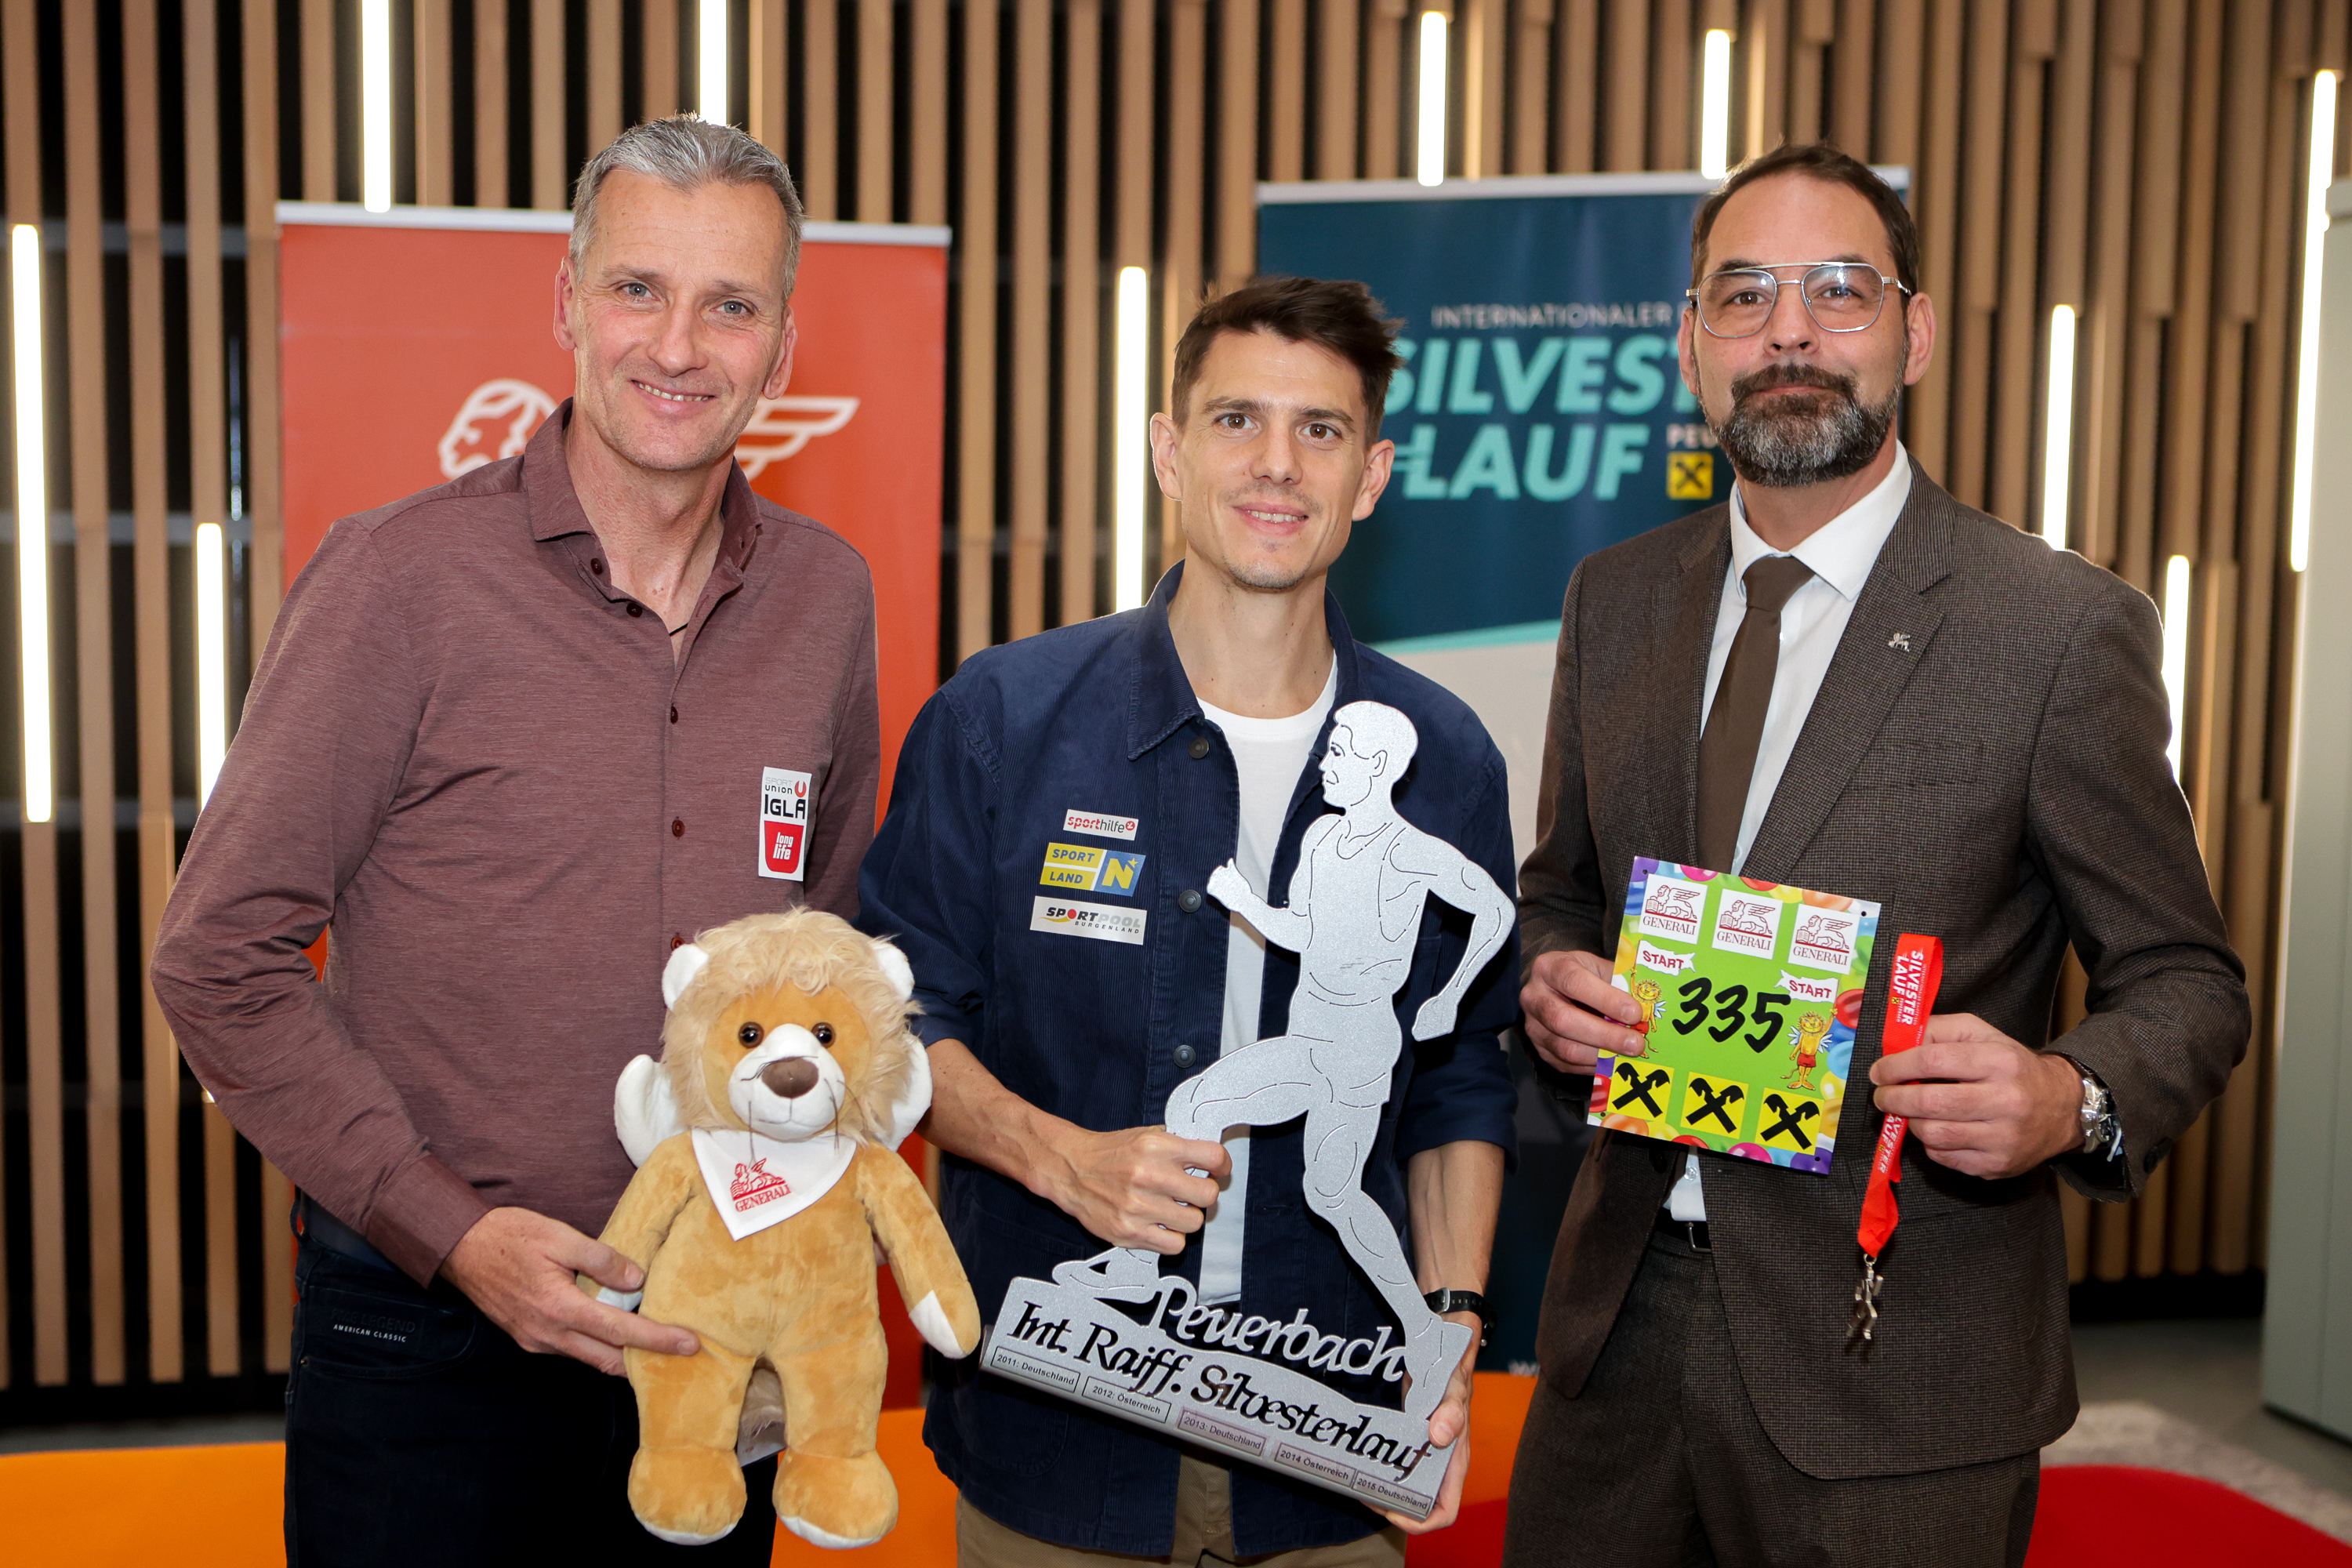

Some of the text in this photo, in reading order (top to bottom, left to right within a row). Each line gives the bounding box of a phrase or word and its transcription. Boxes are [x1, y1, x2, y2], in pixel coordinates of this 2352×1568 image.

[1431, 303, 1673, 328] INTERNATIONALER
[1402, 423, 1650, 502] LAUF
[764, 785, 793, 795] union
[765, 777, 793, 787] SPORT
[764, 793, 806, 820] IGLA
[1067, 816, 1125, 833] sporthilfe
[775, 832, 794, 848] long
[772, 844, 792, 860] life
[1051, 848, 1095, 862] SPORT
[1049, 871, 1083, 884] LAND
[1075, 920, 1139, 934] BURGENLAND
[1642, 916, 1697, 936] GENERALI
[1717, 931, 1772, 951] GENERALI
[1642, 949, 1684, 970] START
[1793, 946, 1849, 966] GENERALI
[1893, 955, 1910, 996] LAUF
[1789, 979, 1832, 1000] START
[1901, 950, 1925, 1025] SILVESTER
[1671, 977, 1791, 1054] 335
[735, 1184, 792, 1213] GENERALI
[333, 1323, 407, 1343] AMERICAN CLASSIC
[1145, 1275, 1406, 1382] Peuerbach
[997, 1354, 1075, 1386] 2011: Deutschland
[1007, 1301, 1432, 1483] Int. Raiff. Silvesterlauf
[1092, 1385, 1161, 1414] 2012: Österreich
[1184, 1417, 1261, 1450] 2013: Deutschland
[1279, 1450, 1348, 1481] 2014 Österreich
[1356, 1477, 1428, 1510] 2015 Deutschland
